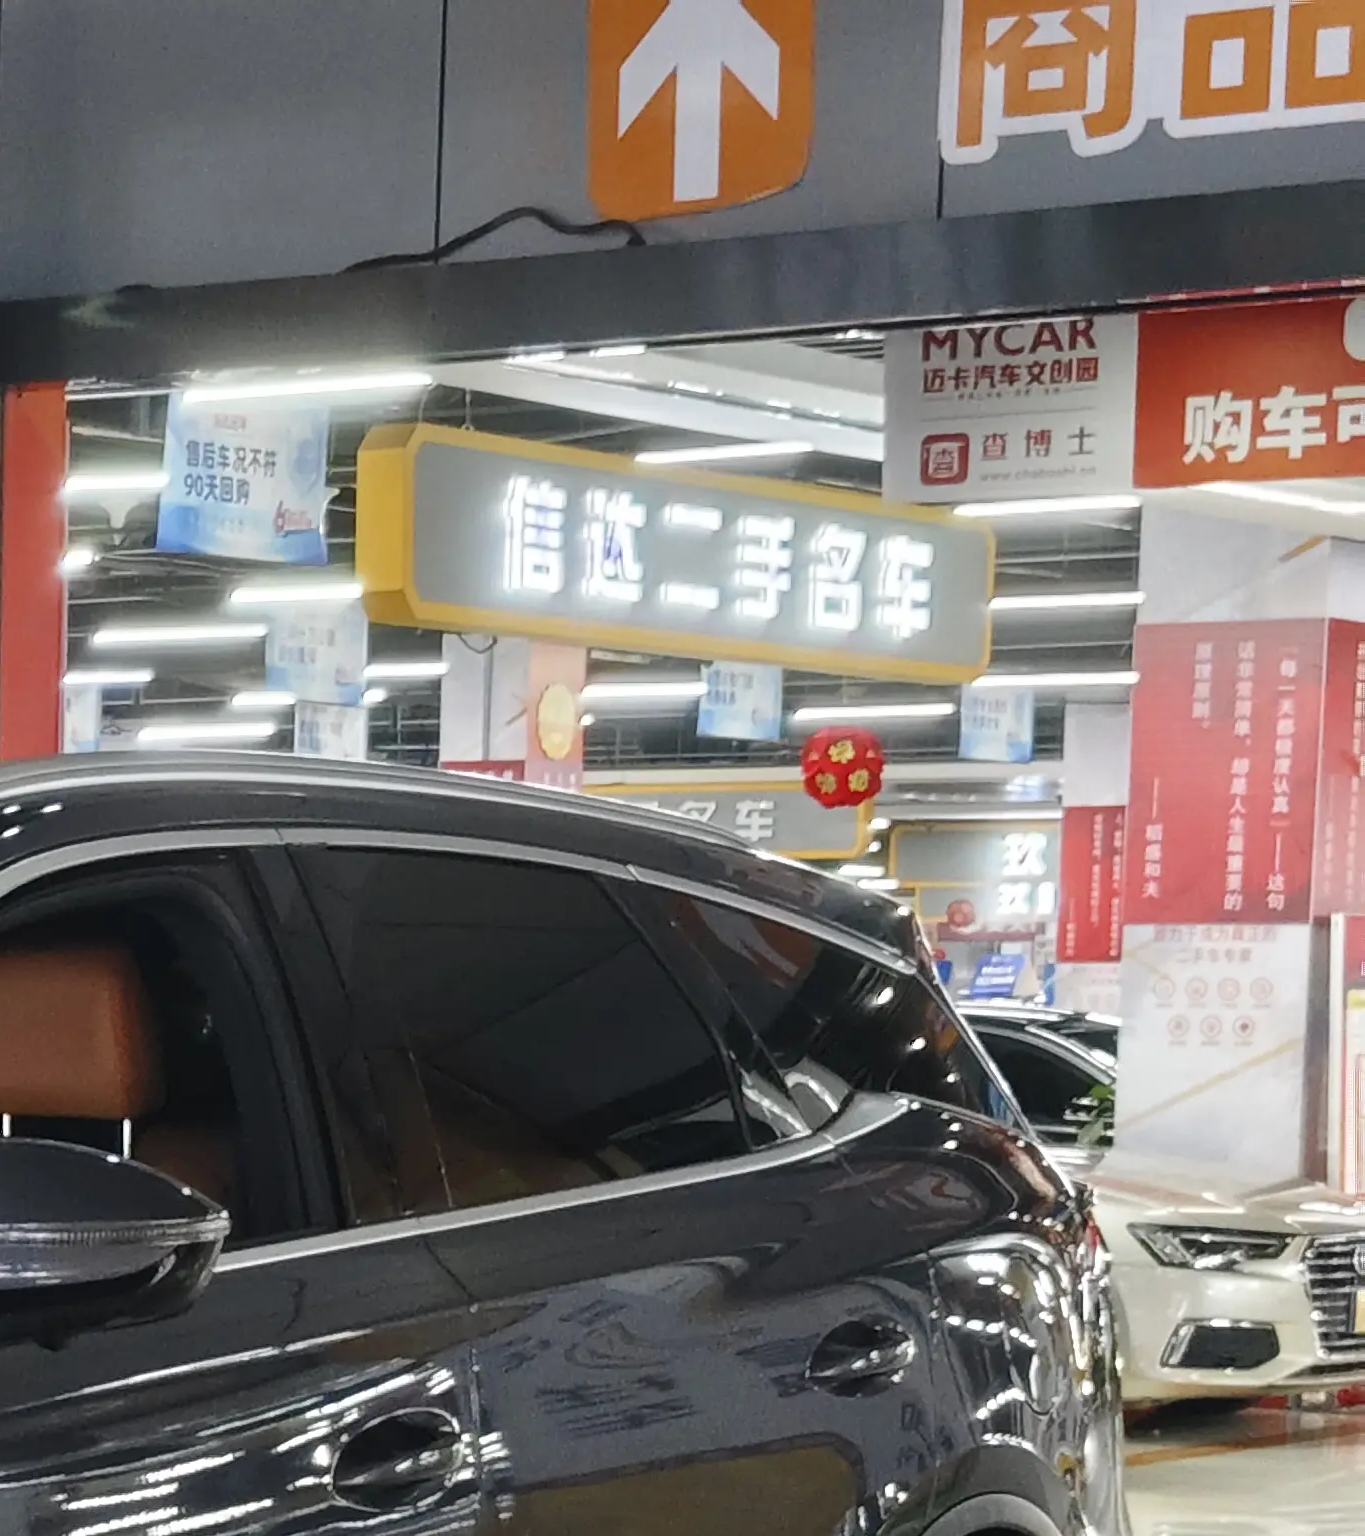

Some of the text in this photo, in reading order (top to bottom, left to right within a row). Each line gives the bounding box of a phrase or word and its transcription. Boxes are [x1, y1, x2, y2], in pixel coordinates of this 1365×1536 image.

[921, 316, 1098, 362] MYCAR
[923, 357, 1099, 393] 迈卡汽车文创园
[184, 440, 278, 478] 售后车况不符
[981, 426, 1097, 461] 查博士
[183, 473, 250, 506] 90天回购
[503, 473, 935, 640] 信达二手名车
